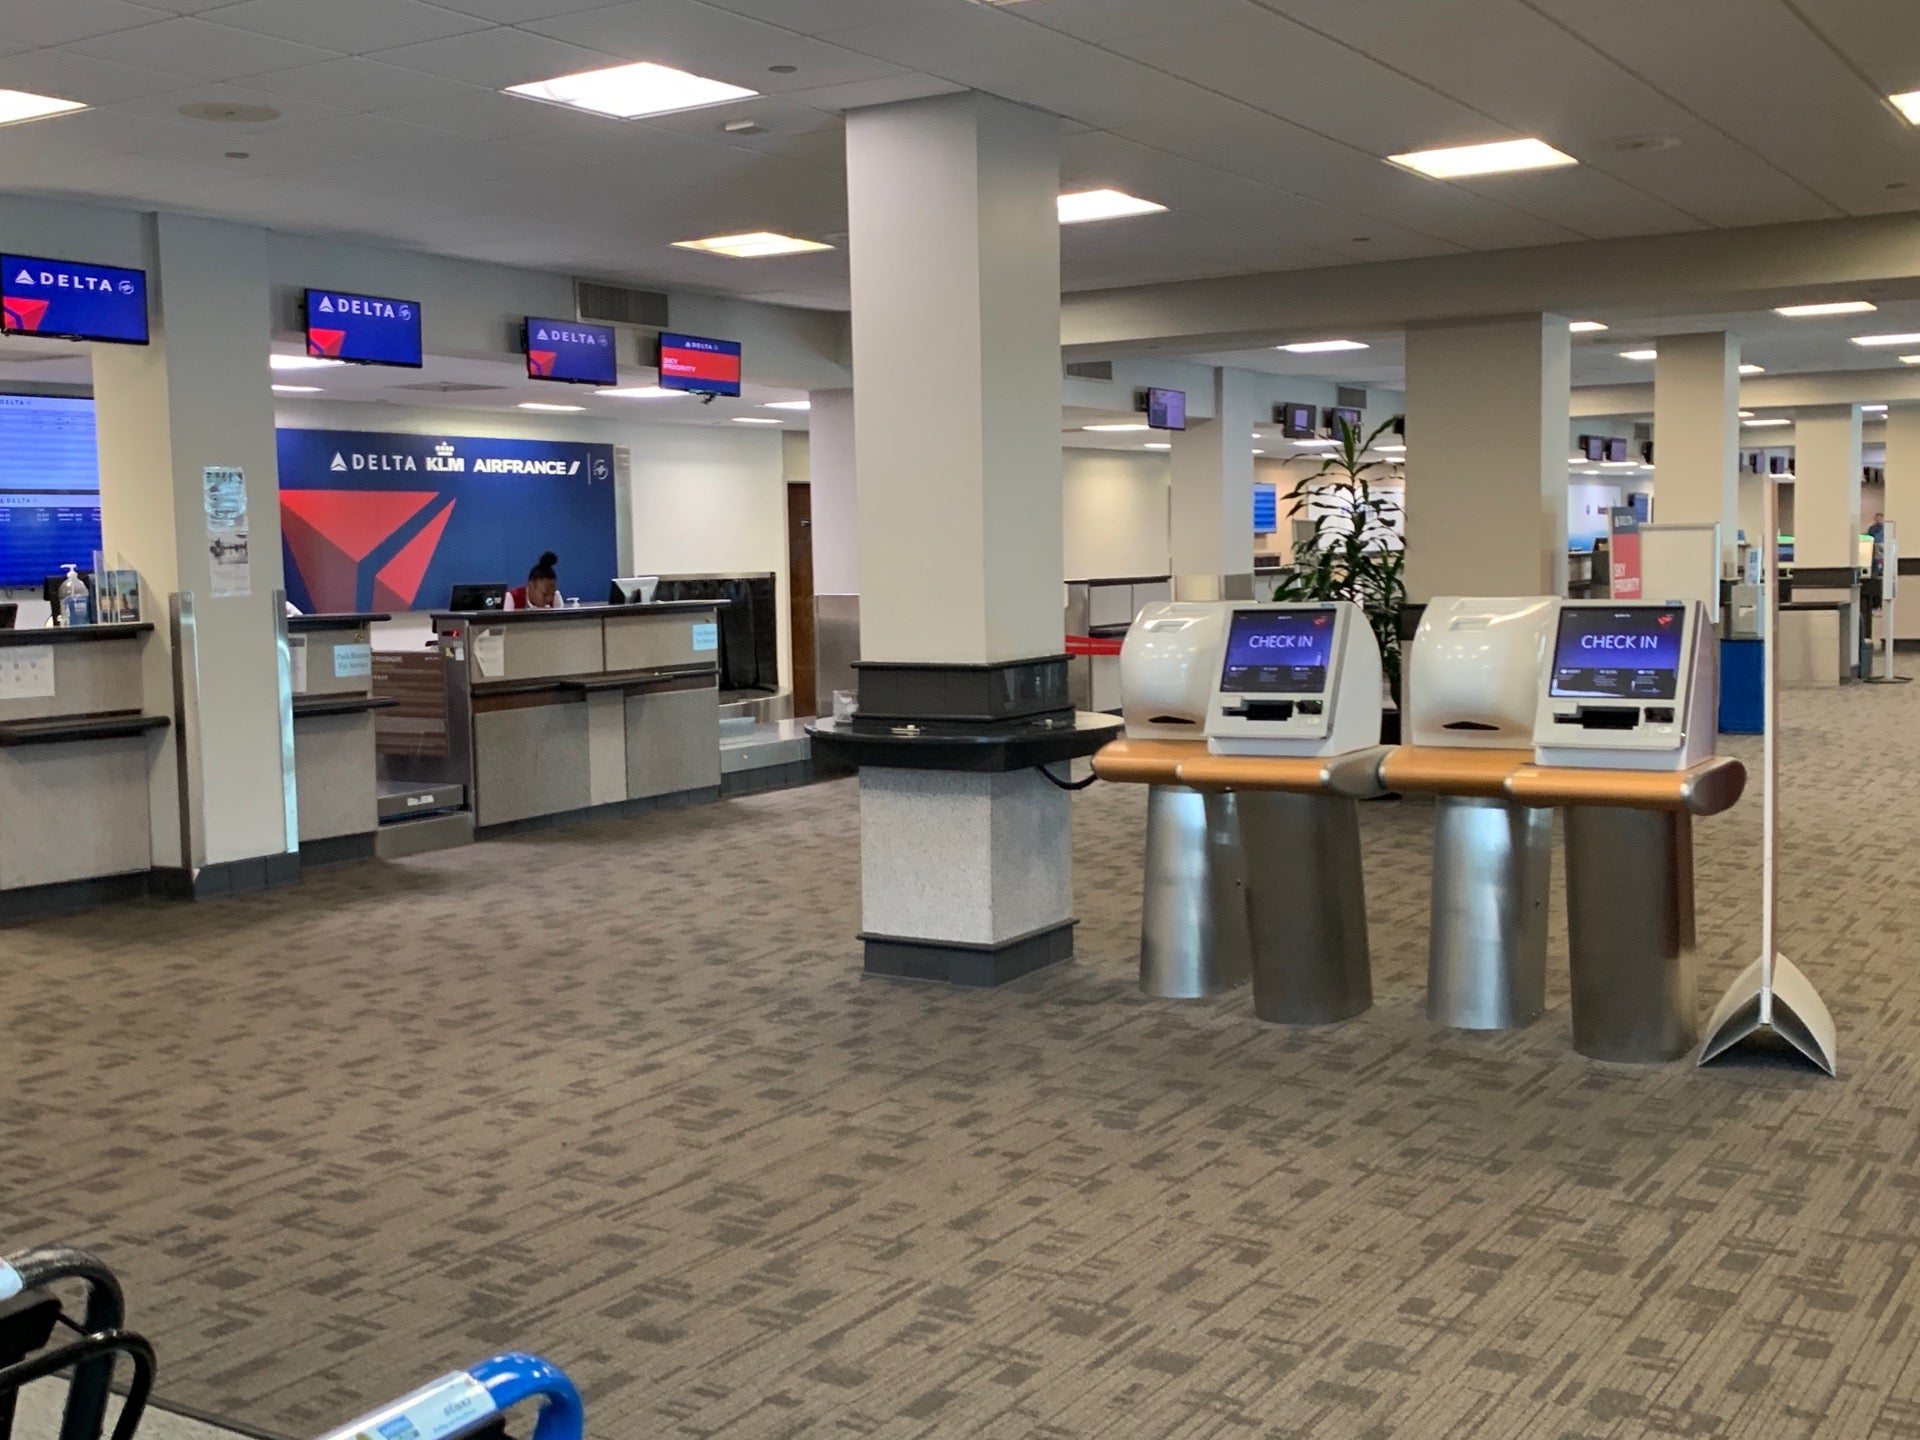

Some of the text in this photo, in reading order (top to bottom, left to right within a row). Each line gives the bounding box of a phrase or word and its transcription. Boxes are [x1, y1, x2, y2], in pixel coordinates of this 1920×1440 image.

[40, 271, 113, 292] DELTA
[338, 298, 395, 319] DELTA
[551, 330, 596, 345] DELTA
[691, 342, 713, 350] DELTA
[663, 357, 679, 365] SKY
[663, 363, 697, 373] PRIORITY
[351, 453, 567, 475] DELTA KLM AIRFRANCE
[1248, 635, 1314, 648] CHECK IN
[1581, 634, 1659, 649] CHECK IN
